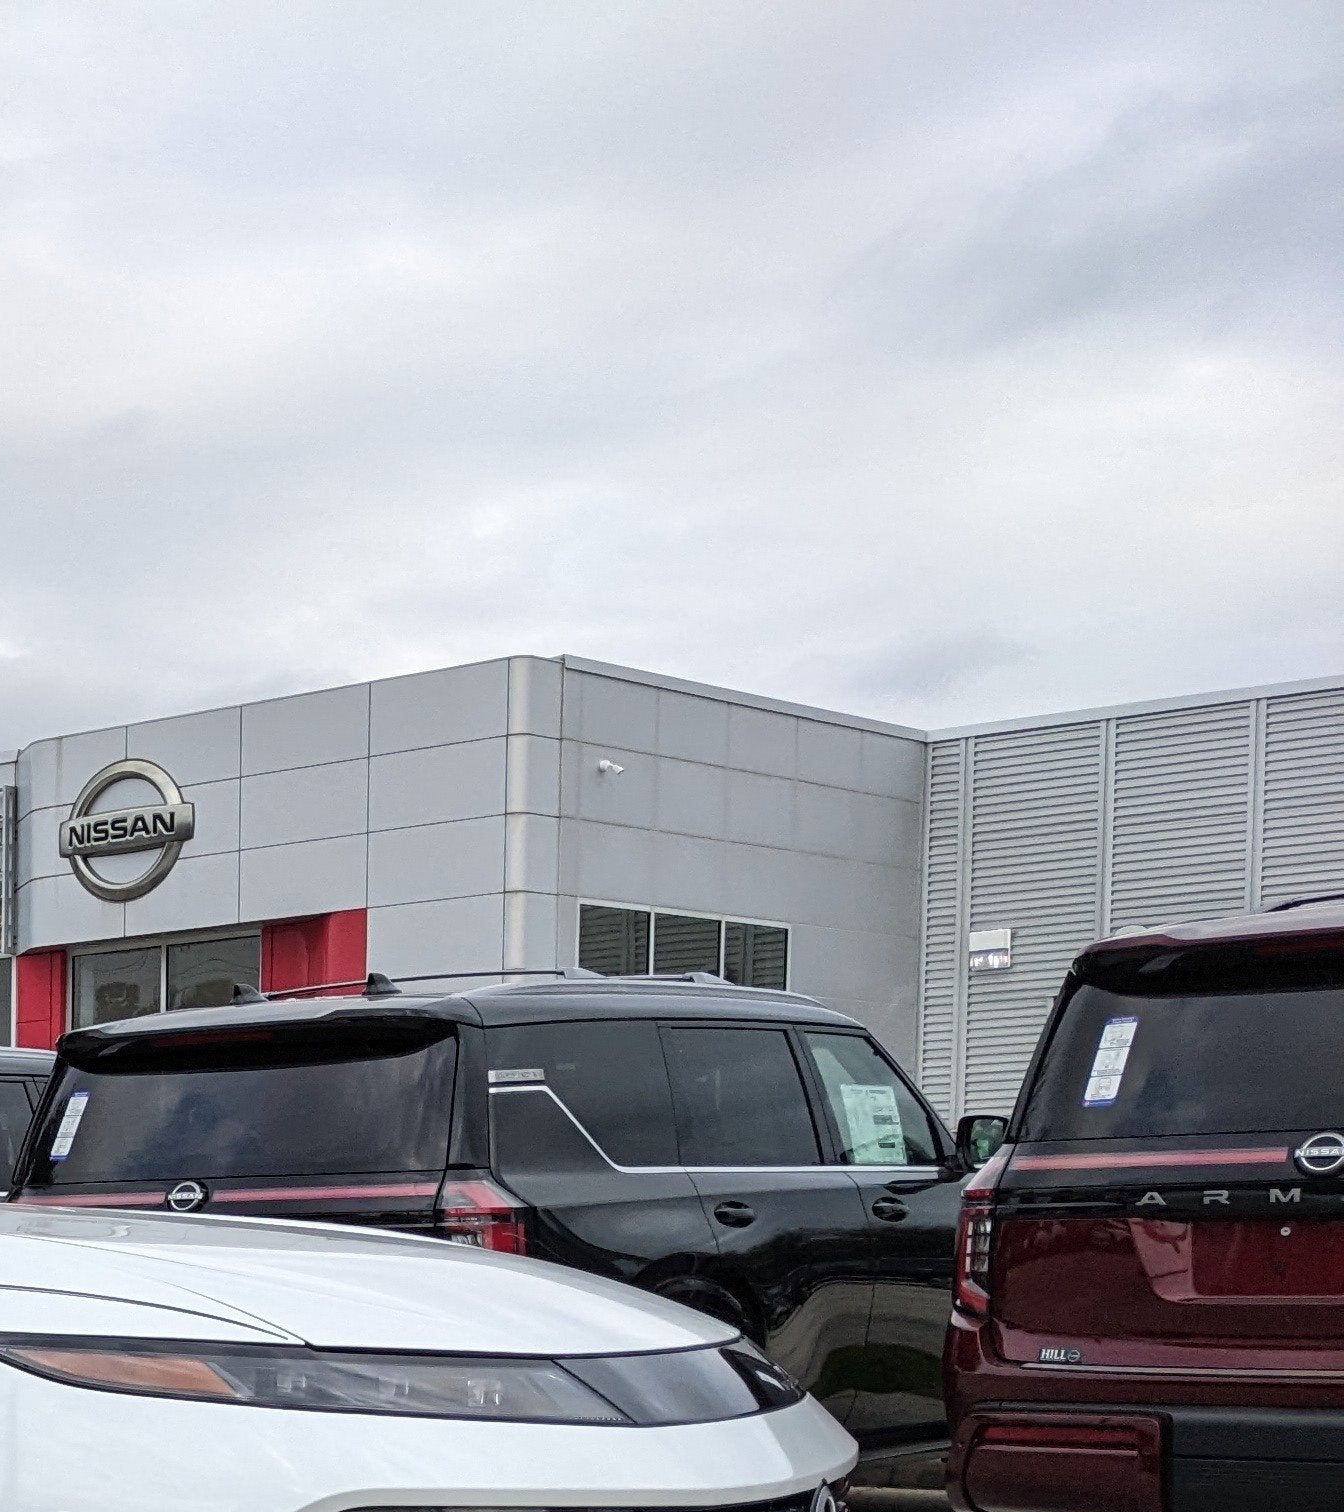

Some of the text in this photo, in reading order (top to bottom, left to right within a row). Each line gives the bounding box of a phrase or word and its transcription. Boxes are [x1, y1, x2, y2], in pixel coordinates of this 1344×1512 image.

[68, 811, 176, 848] NISSAN
[1295, 1148, 1344, 1159] NISSA
[1135, 1187, 1344, 1206] ARM
[1040, 1348, 1067, 1361] HILL
